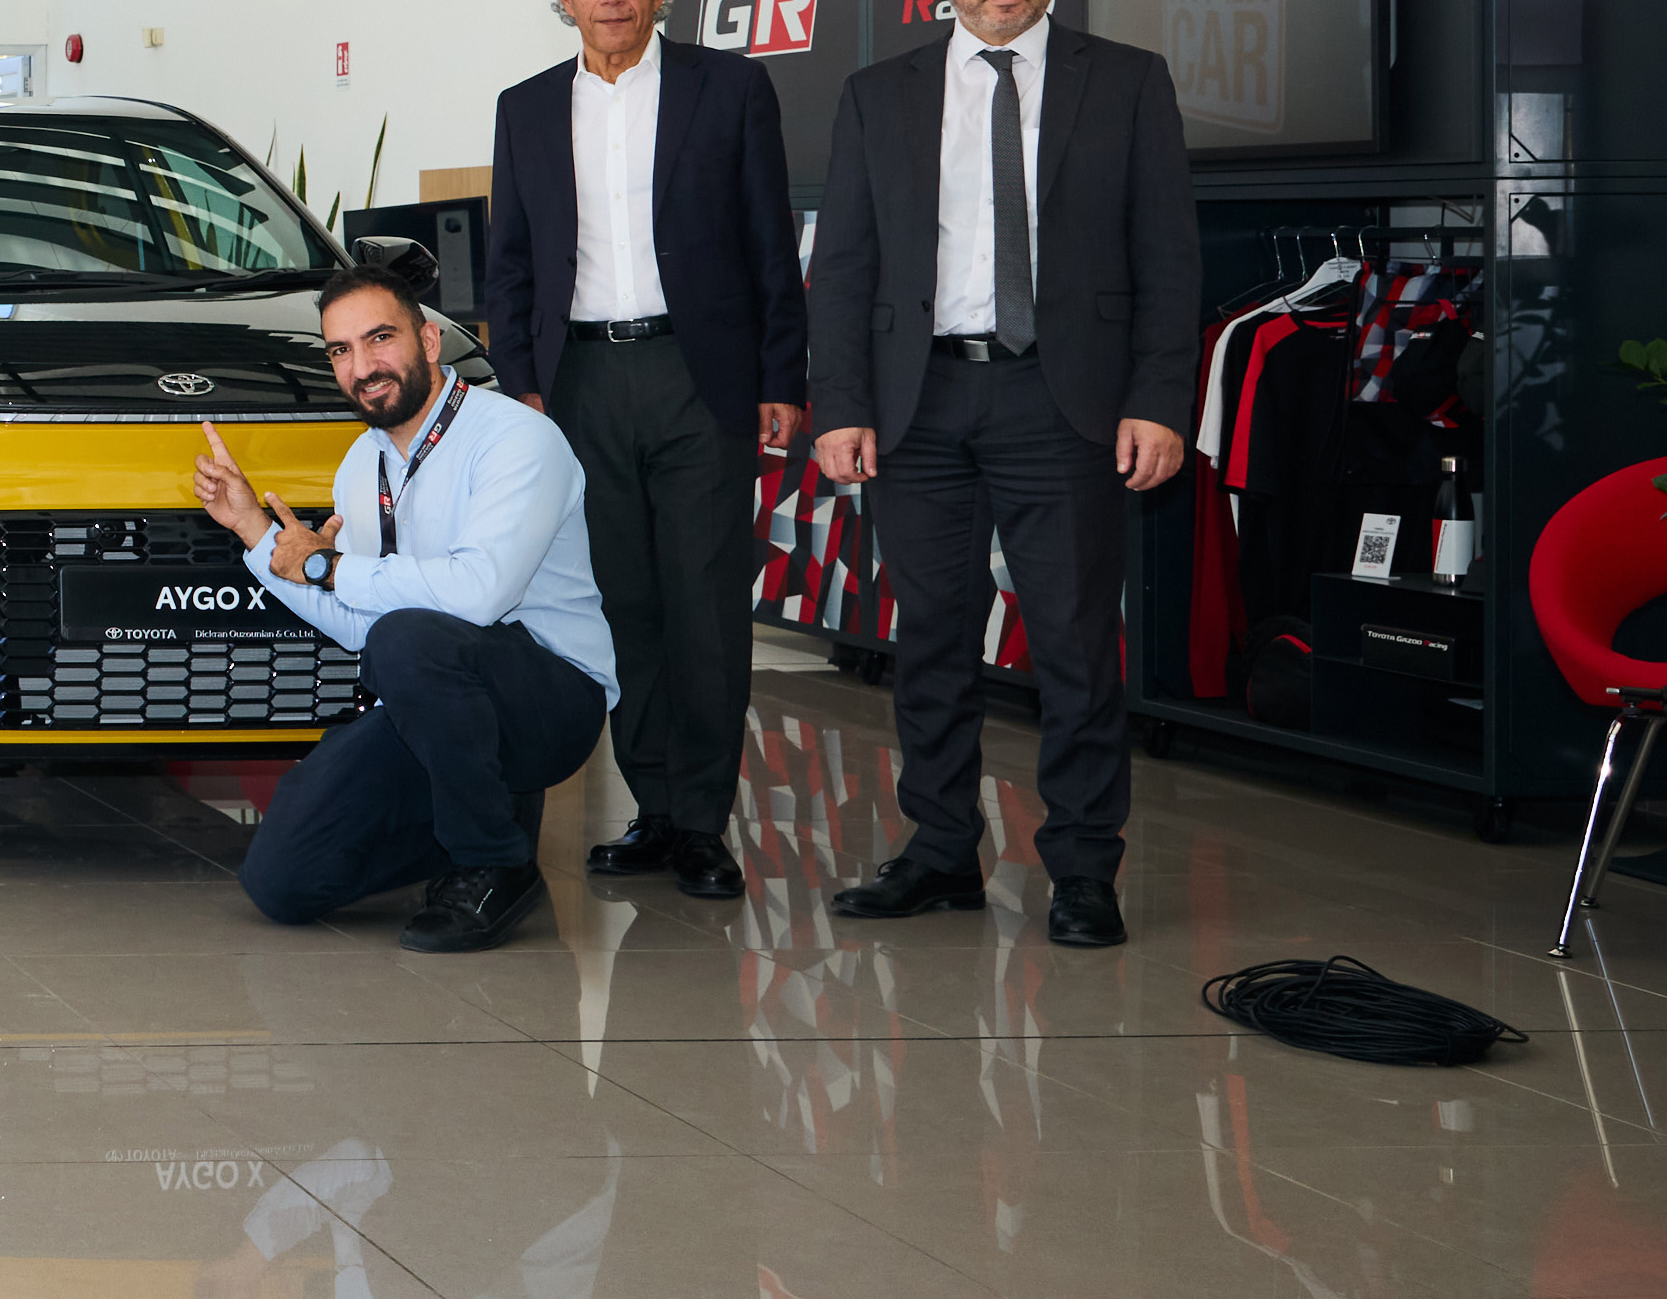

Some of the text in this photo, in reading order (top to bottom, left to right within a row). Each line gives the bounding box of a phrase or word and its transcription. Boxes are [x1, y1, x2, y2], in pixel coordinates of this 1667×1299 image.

[1171, 8, 1269, 107] CAR
[428, 422, 443, 442] GR
[383, 495, 392, 515] GR
[155, 585, 267, 611] AYGO X
[124, 628, 177, 640] TOYOTA
[195, 629, 316, 638] Dickran Ouzounian & Co. Ltd.
[1396, 635, 1423, 646] GAZOO
